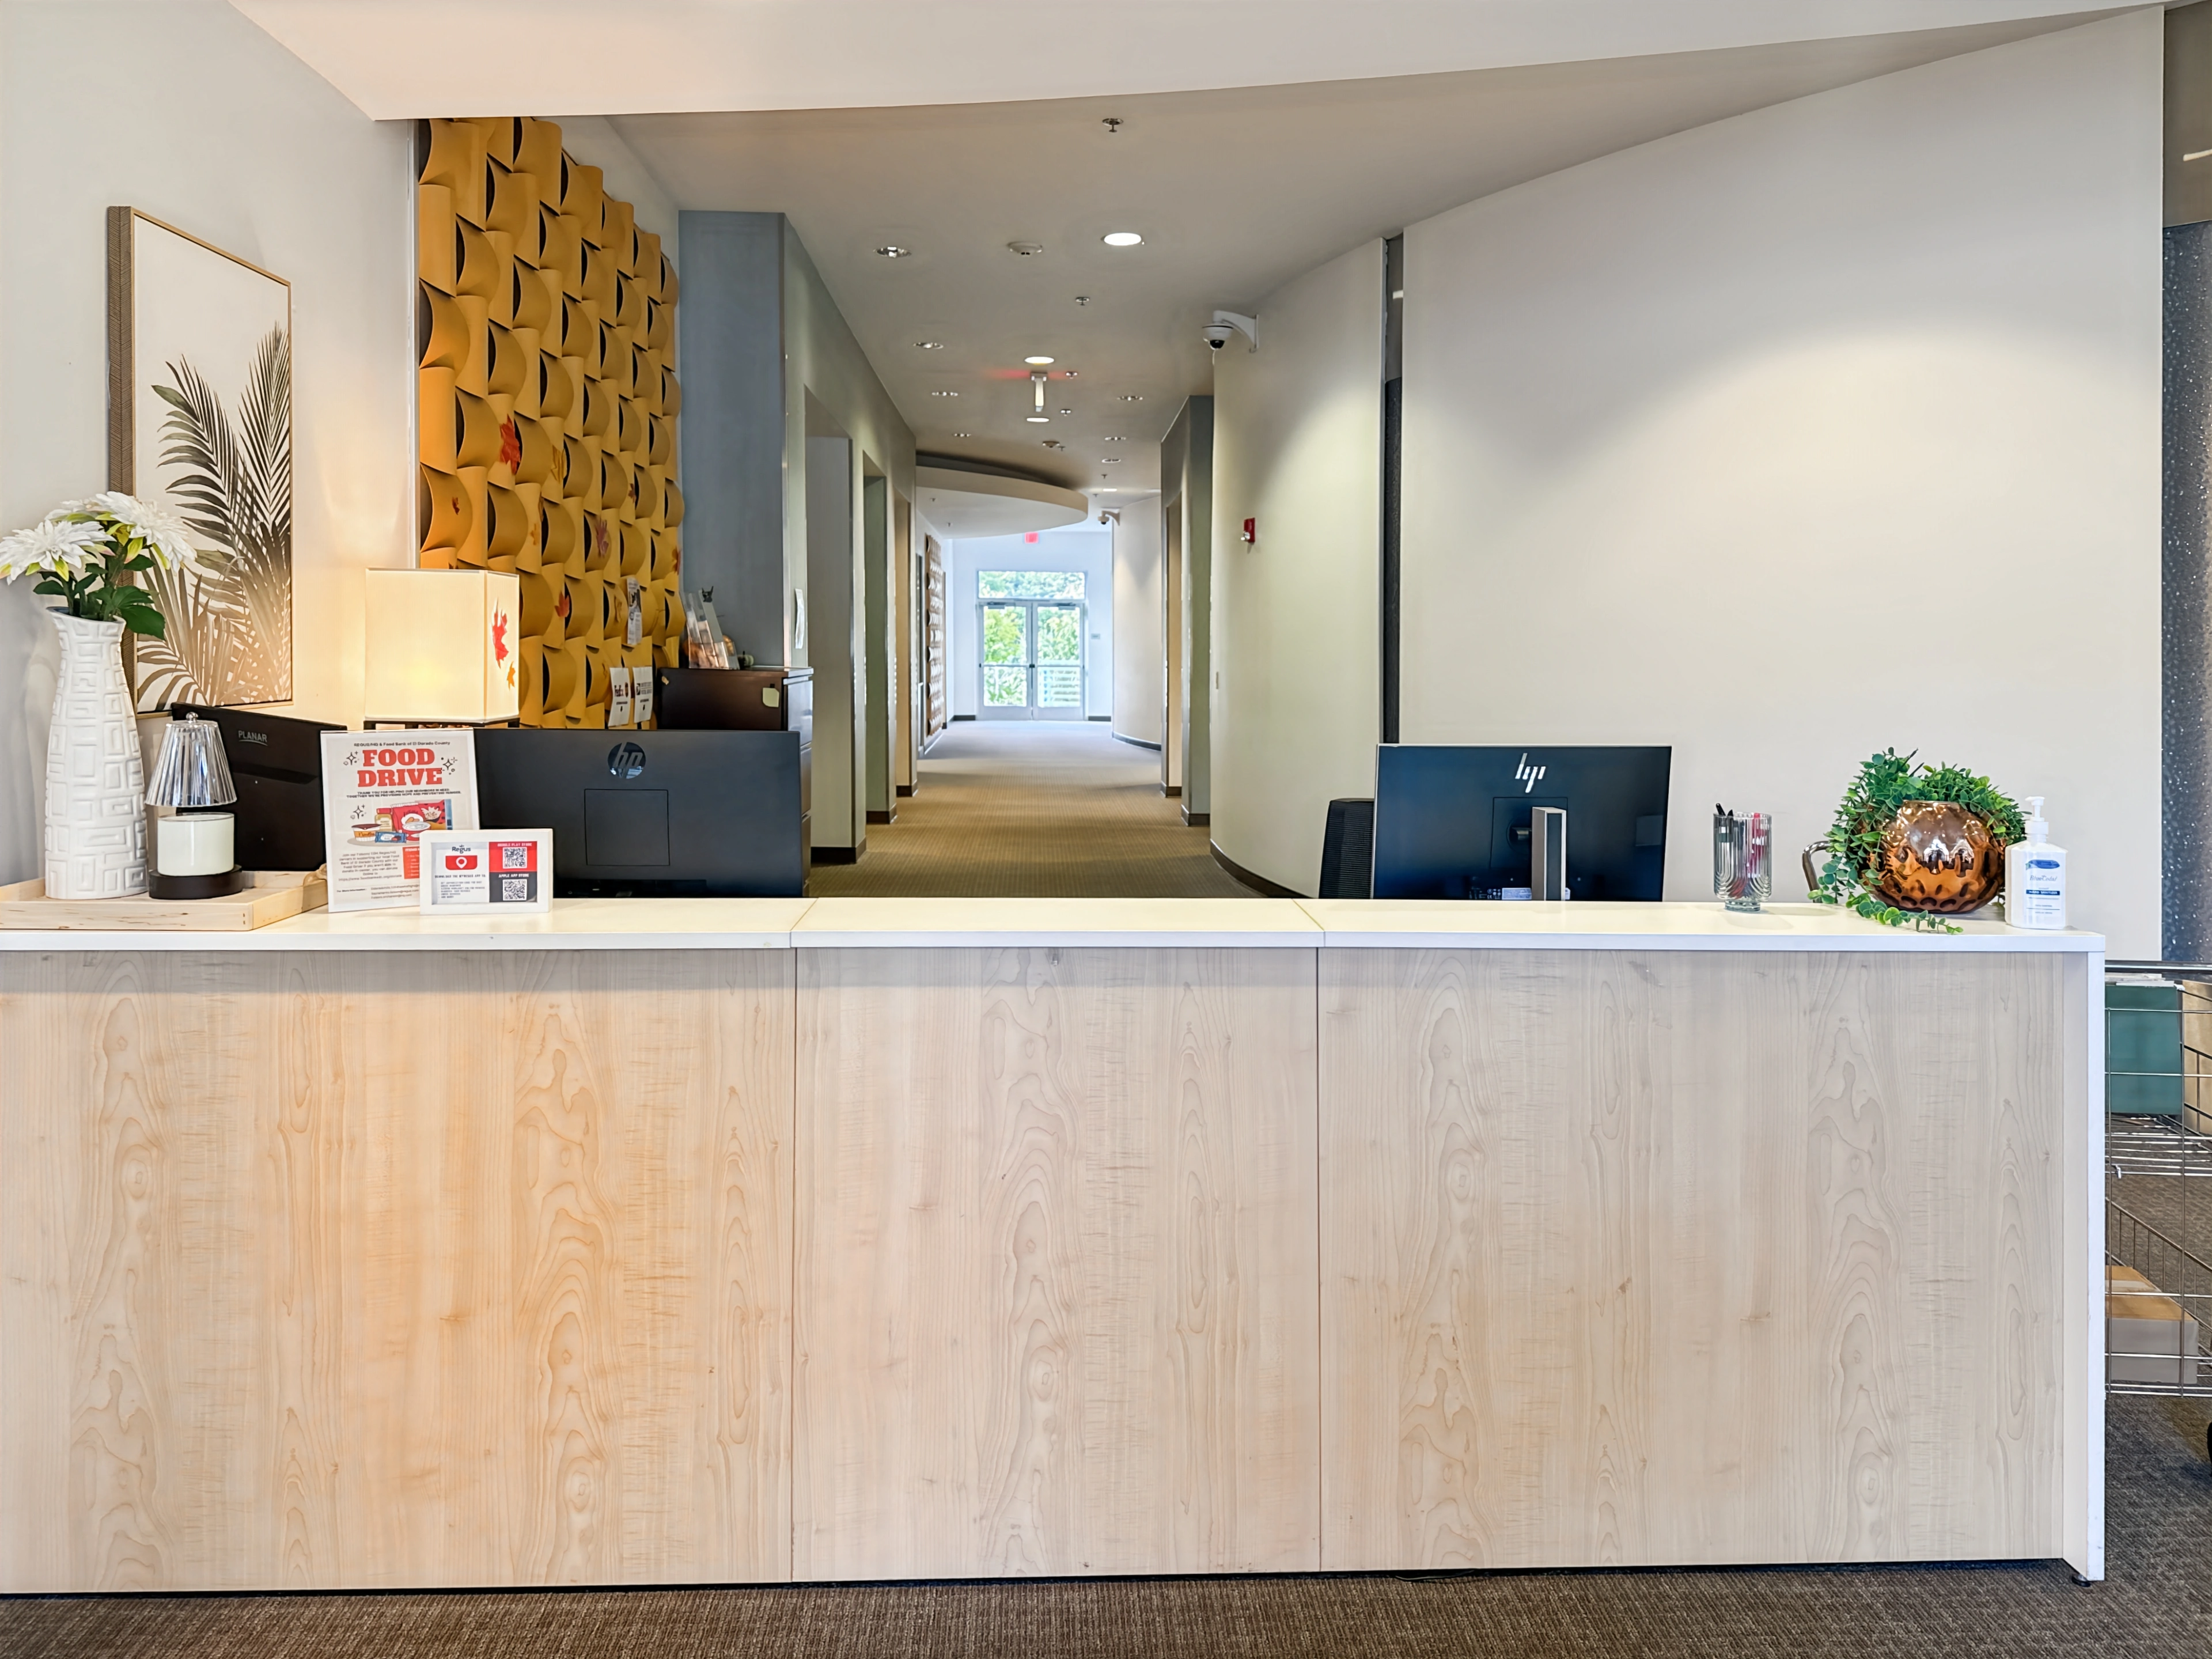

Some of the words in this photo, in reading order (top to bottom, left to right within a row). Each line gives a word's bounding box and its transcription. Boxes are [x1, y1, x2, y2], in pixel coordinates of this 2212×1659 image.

[238, 730, 267, 743] PLANAR
[362, 748, 435, 767] FOOD
[611, 742, 644, 779] hp
[357, 767, 442, 787] DRIVE
[1515, 753, 1546, 793] hp
